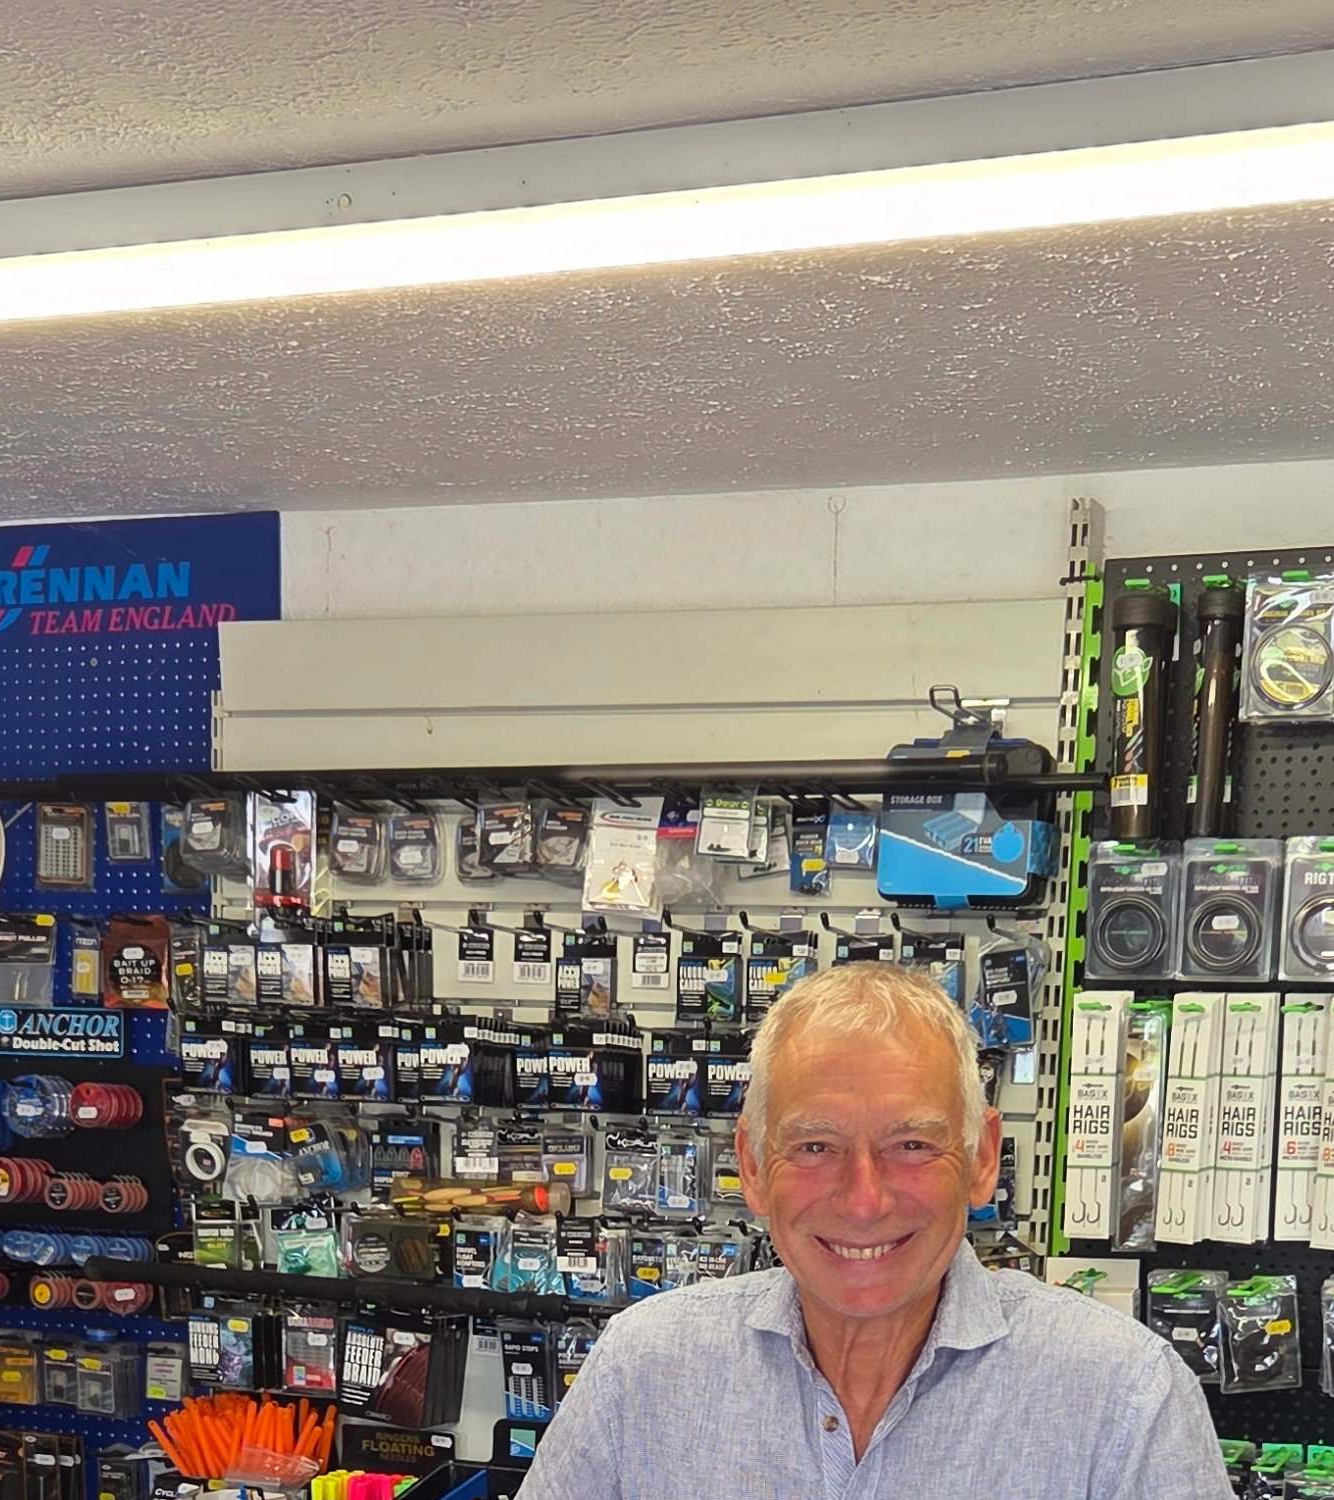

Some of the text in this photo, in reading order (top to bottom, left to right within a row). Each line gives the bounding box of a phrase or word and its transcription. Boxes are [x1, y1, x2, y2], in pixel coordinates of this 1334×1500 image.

[30, 603, 236, 636] TEAM ENGLAND
[926, 794, 943, 804] BOX
[963, 837, 978, 852] 21
[1304, 872, 1327, 885] RIG
[118, 968, 151, 976] BRAID
[18, 1014, 119, 1037] ANCHOR
[88, 1039, 120, 1052] Shot
[250, 1050, 287, 1064] POWER
[291, 1049, 329, 1064] POWER
[338, 1050, 377, 1065] POWER
[549, 1057, 590, 1072] POWER
[1073, 1105, 1110, 1119] HAIR
[1167, 1108, 1199, 1123] HAIR
[1222, 1106, 1256, 1121] HAIR
[1284, 1106, 1322, 1120] HAIR
[1073, 1120, 1109, 1134] RIGS
[1166, 1123, 1198, 1139] RIGS
[1221, 1121, 1255, 1137] RIGS
[1284, 1121, 1321, 1136] RIGS
[376, 1432, 420, 1444] RINGERS
[361, 1440, 435, 1457] FLOATING
